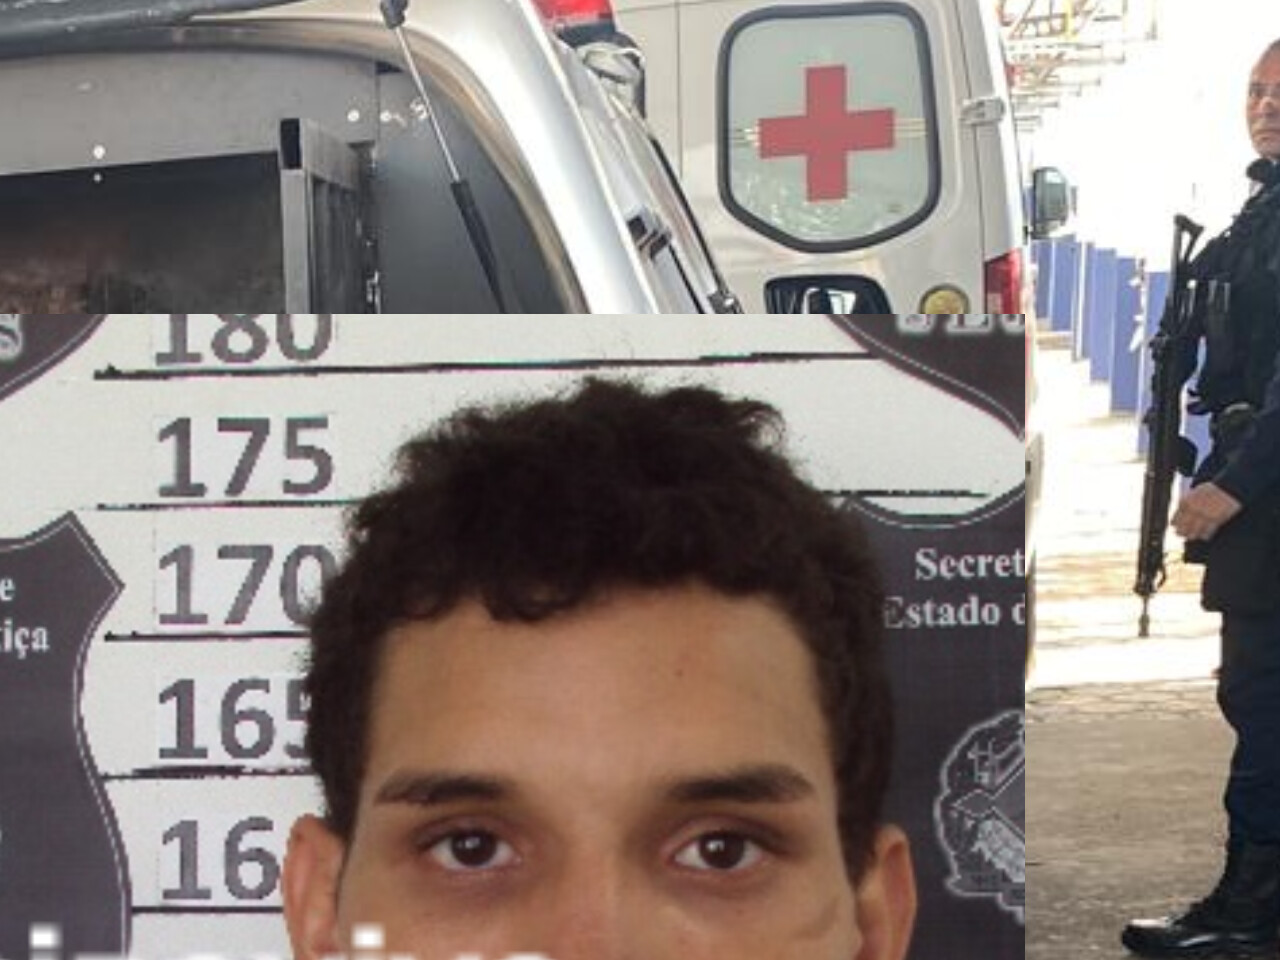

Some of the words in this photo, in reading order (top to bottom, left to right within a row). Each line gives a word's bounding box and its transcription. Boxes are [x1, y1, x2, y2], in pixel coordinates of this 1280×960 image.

[155, 313, 333, 366] 180
[157, 416, 334, 498] 175
[884, 594, 1000, 628] Estado
[161, 815, 282, 900] 16
